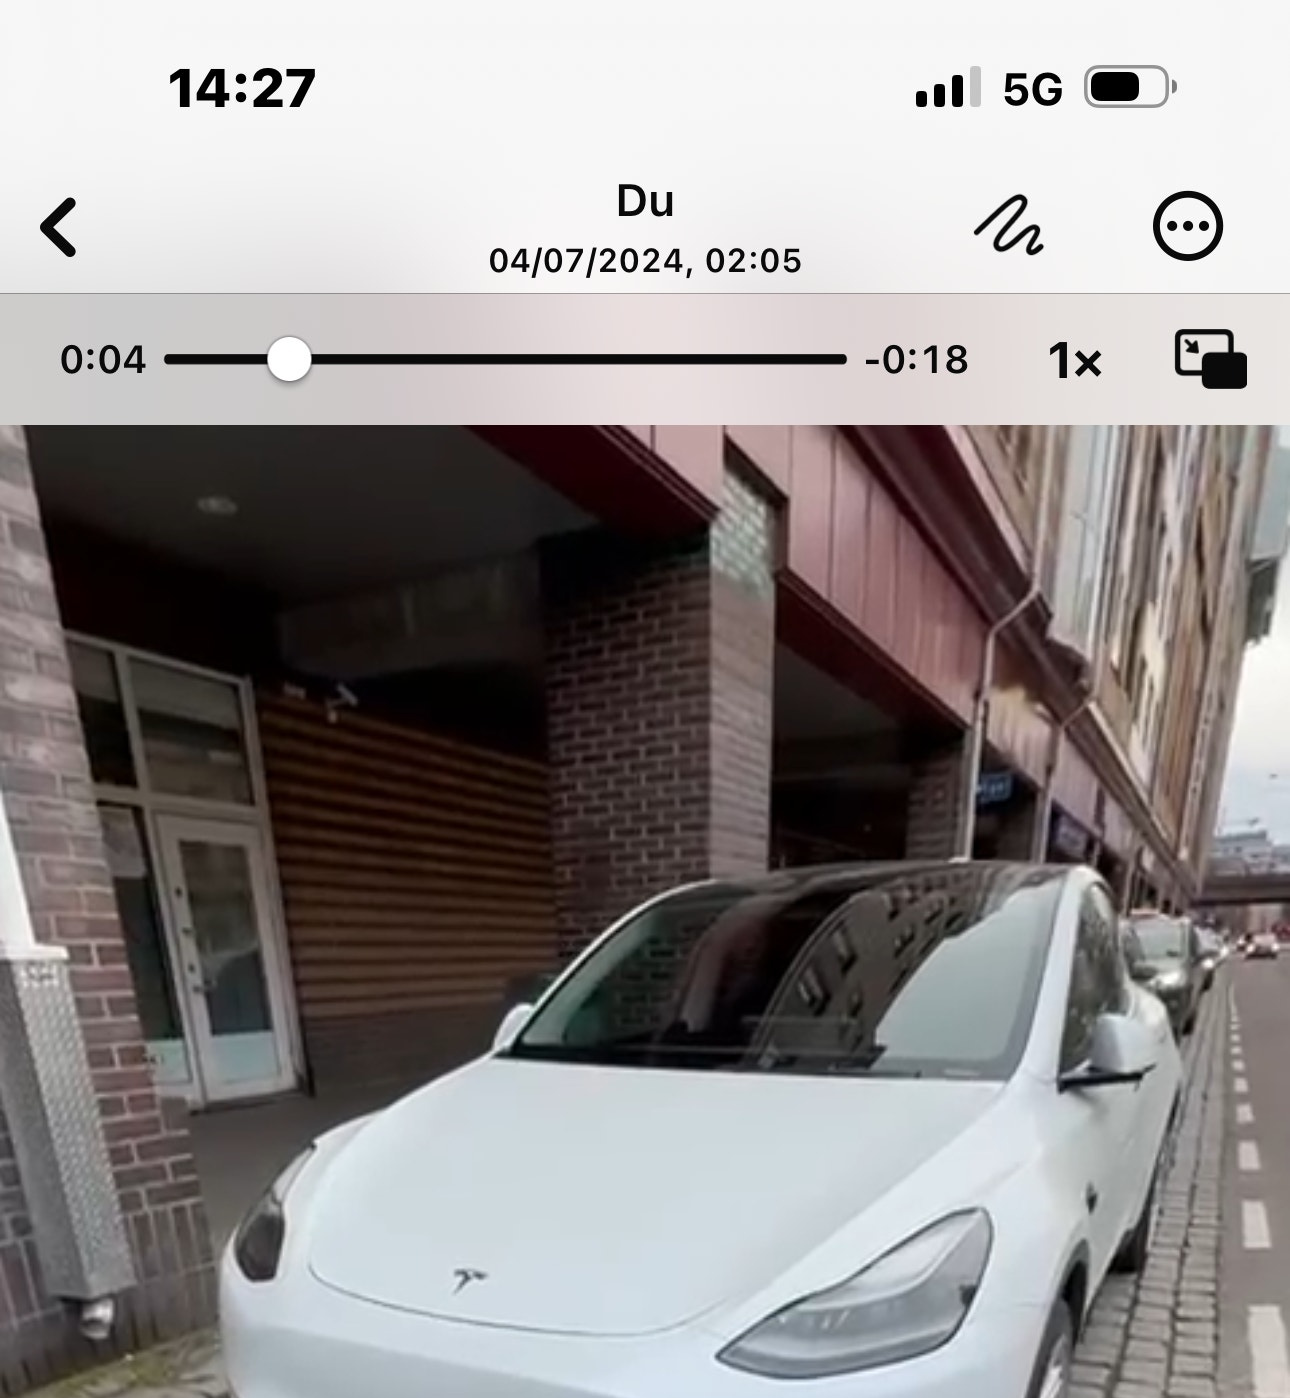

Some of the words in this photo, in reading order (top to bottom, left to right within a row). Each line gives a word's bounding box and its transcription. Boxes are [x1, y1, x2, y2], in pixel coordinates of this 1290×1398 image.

[169, 67, 316, 108] 14:27
[1004, 72, 1063, 107] 5G
[618, 183, 673, 217] Du
[489, 247, 693, 279] 04/07/2024,
[706, 247, 801, 273] 02:05
[60, 344, 146, 375] 0:04
[865, 344, 968, 375] -0:18
